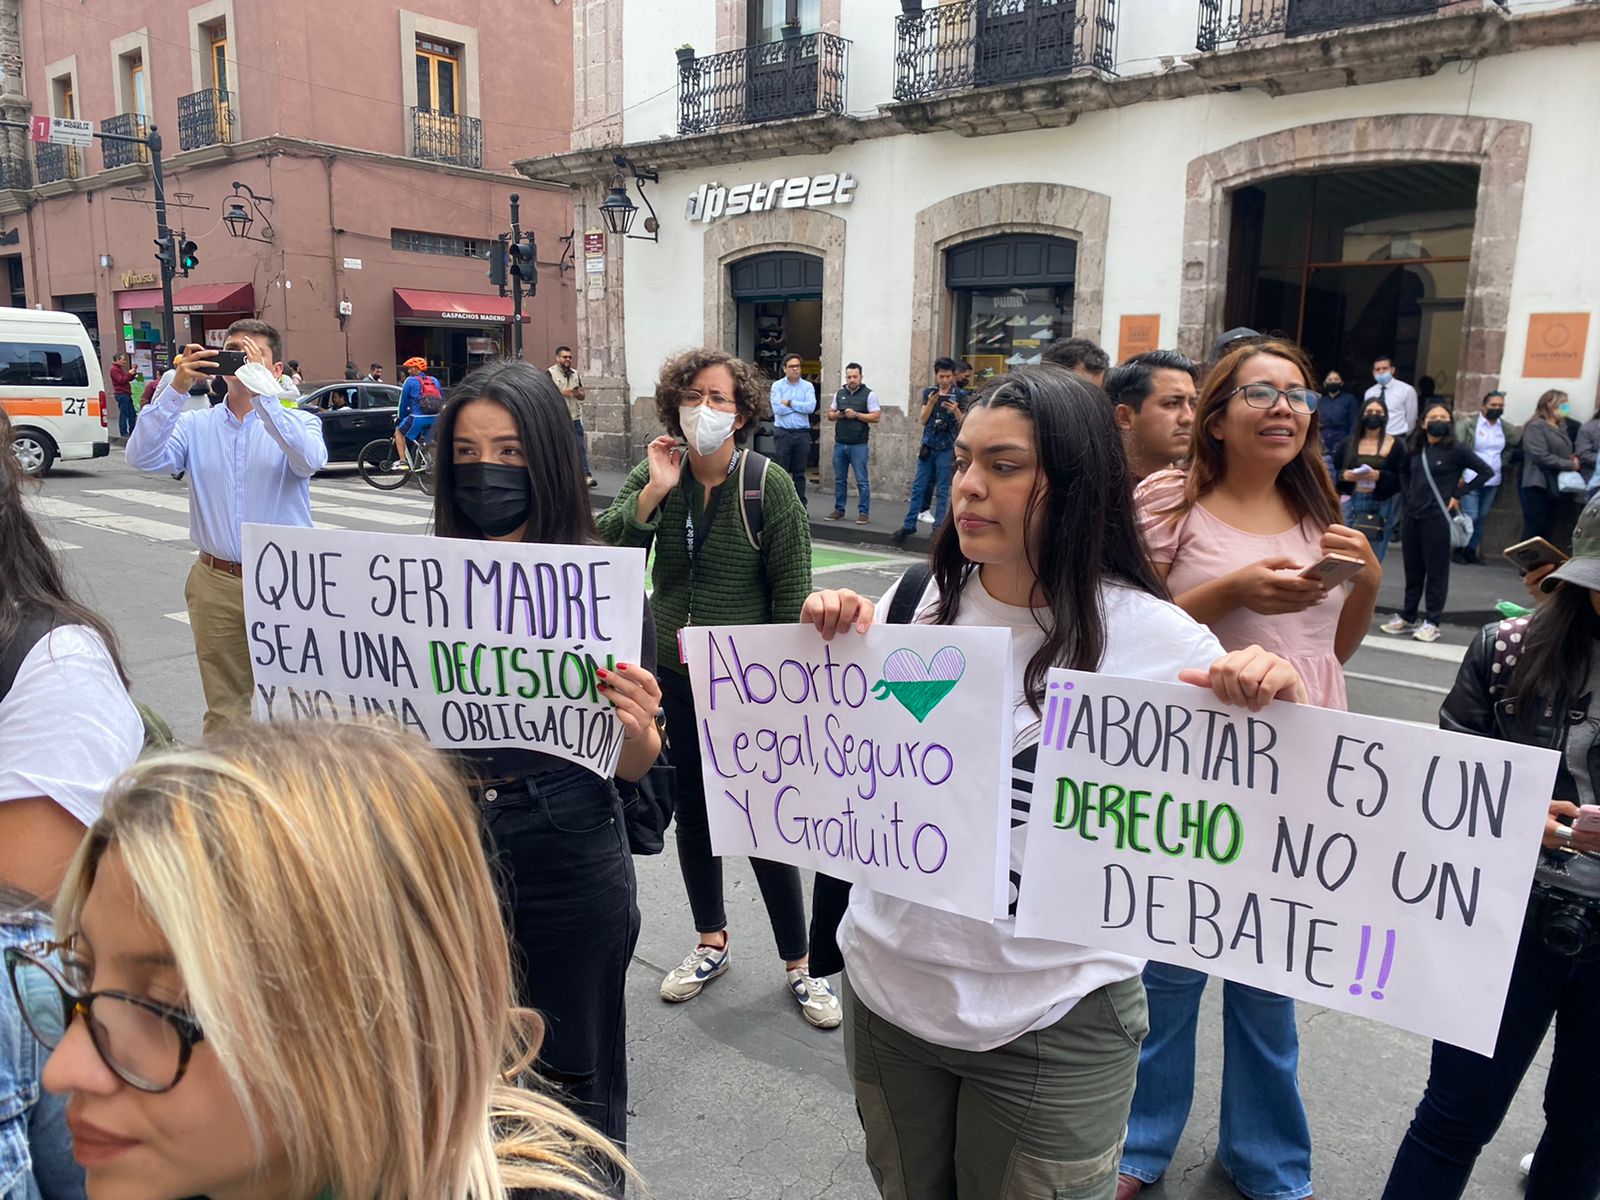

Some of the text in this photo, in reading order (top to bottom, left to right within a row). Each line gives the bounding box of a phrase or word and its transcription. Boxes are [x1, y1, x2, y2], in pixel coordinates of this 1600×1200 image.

[441, 312, 479, 320] GASPACHOS
[993, 296, 1024, 308] PUMA
[65, 397, 85, 416] 27
[255, 541, 612, 642] QUE SER MADRE
[251, 621, 617, 708] SEA UNA DECISIÓN
[708, 631, 867, 709] Aborto
[257, 684, 276, 721] Y
[442, 700, 624, 773] OBLIGACIÓN
[824, 713, 954, 800] Seguro
[724, 789, 758, 849] Y
[774, 785, 948, 874] Gratuito
[1327, 735, 1388, 817] ES
[1422, 756, 1512, 838] UN
[1053, 777, 1245, 865] DERECHO
[1272, 816, 1357, 891] NO
[1392, 851, 1481, 927] UN
[1100, 864, 1396, 1000] DEBATE!!
